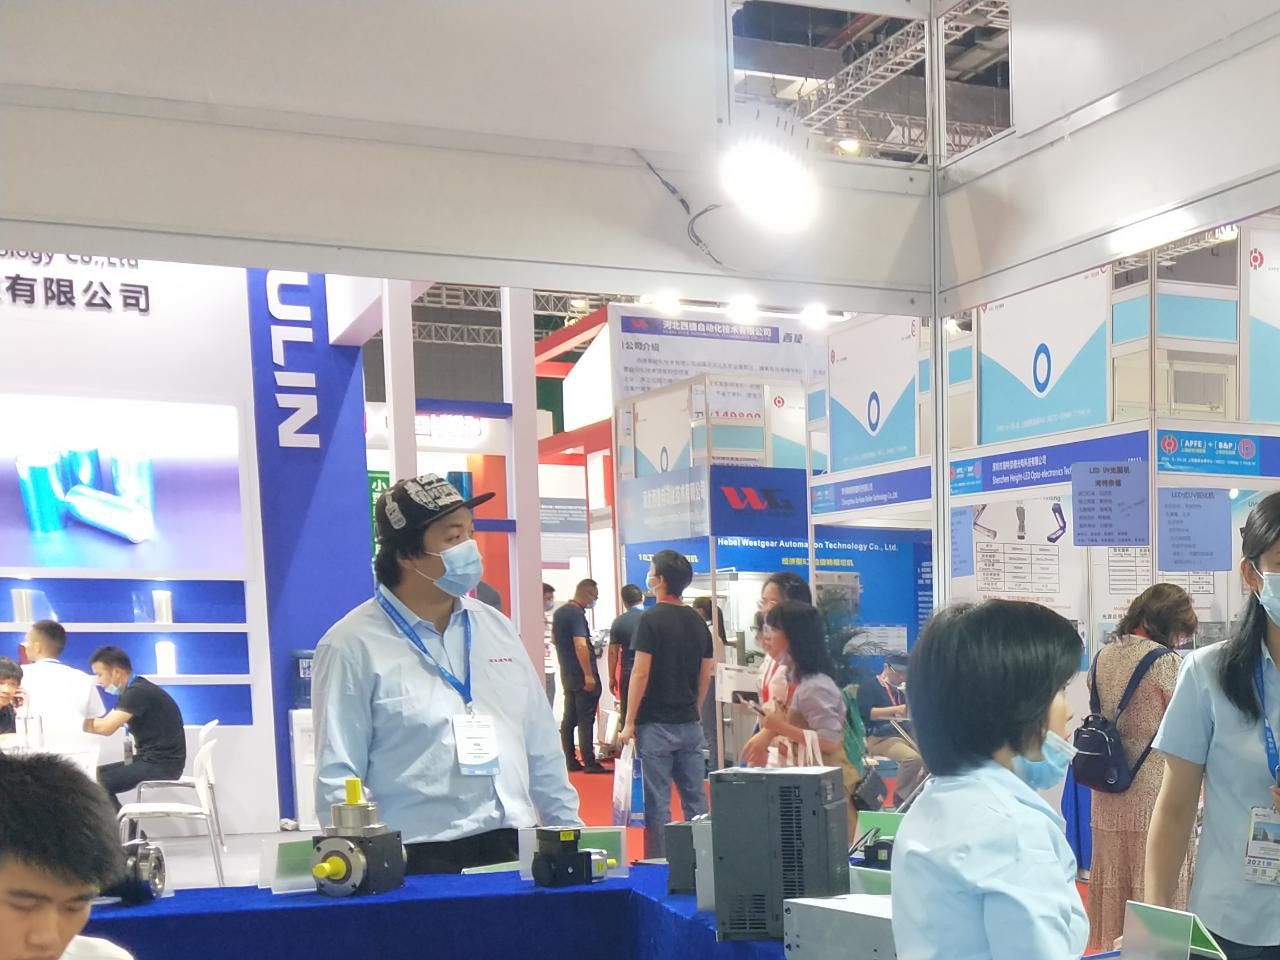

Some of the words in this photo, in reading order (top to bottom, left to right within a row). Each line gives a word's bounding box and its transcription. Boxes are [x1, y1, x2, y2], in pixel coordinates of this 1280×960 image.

[5, 273, 150, 313] 有限公司
[742, 537, 777, 548] Westgear
[779, 539, 823, 549] Automaon
[825, 541, 867, 552] Technology
